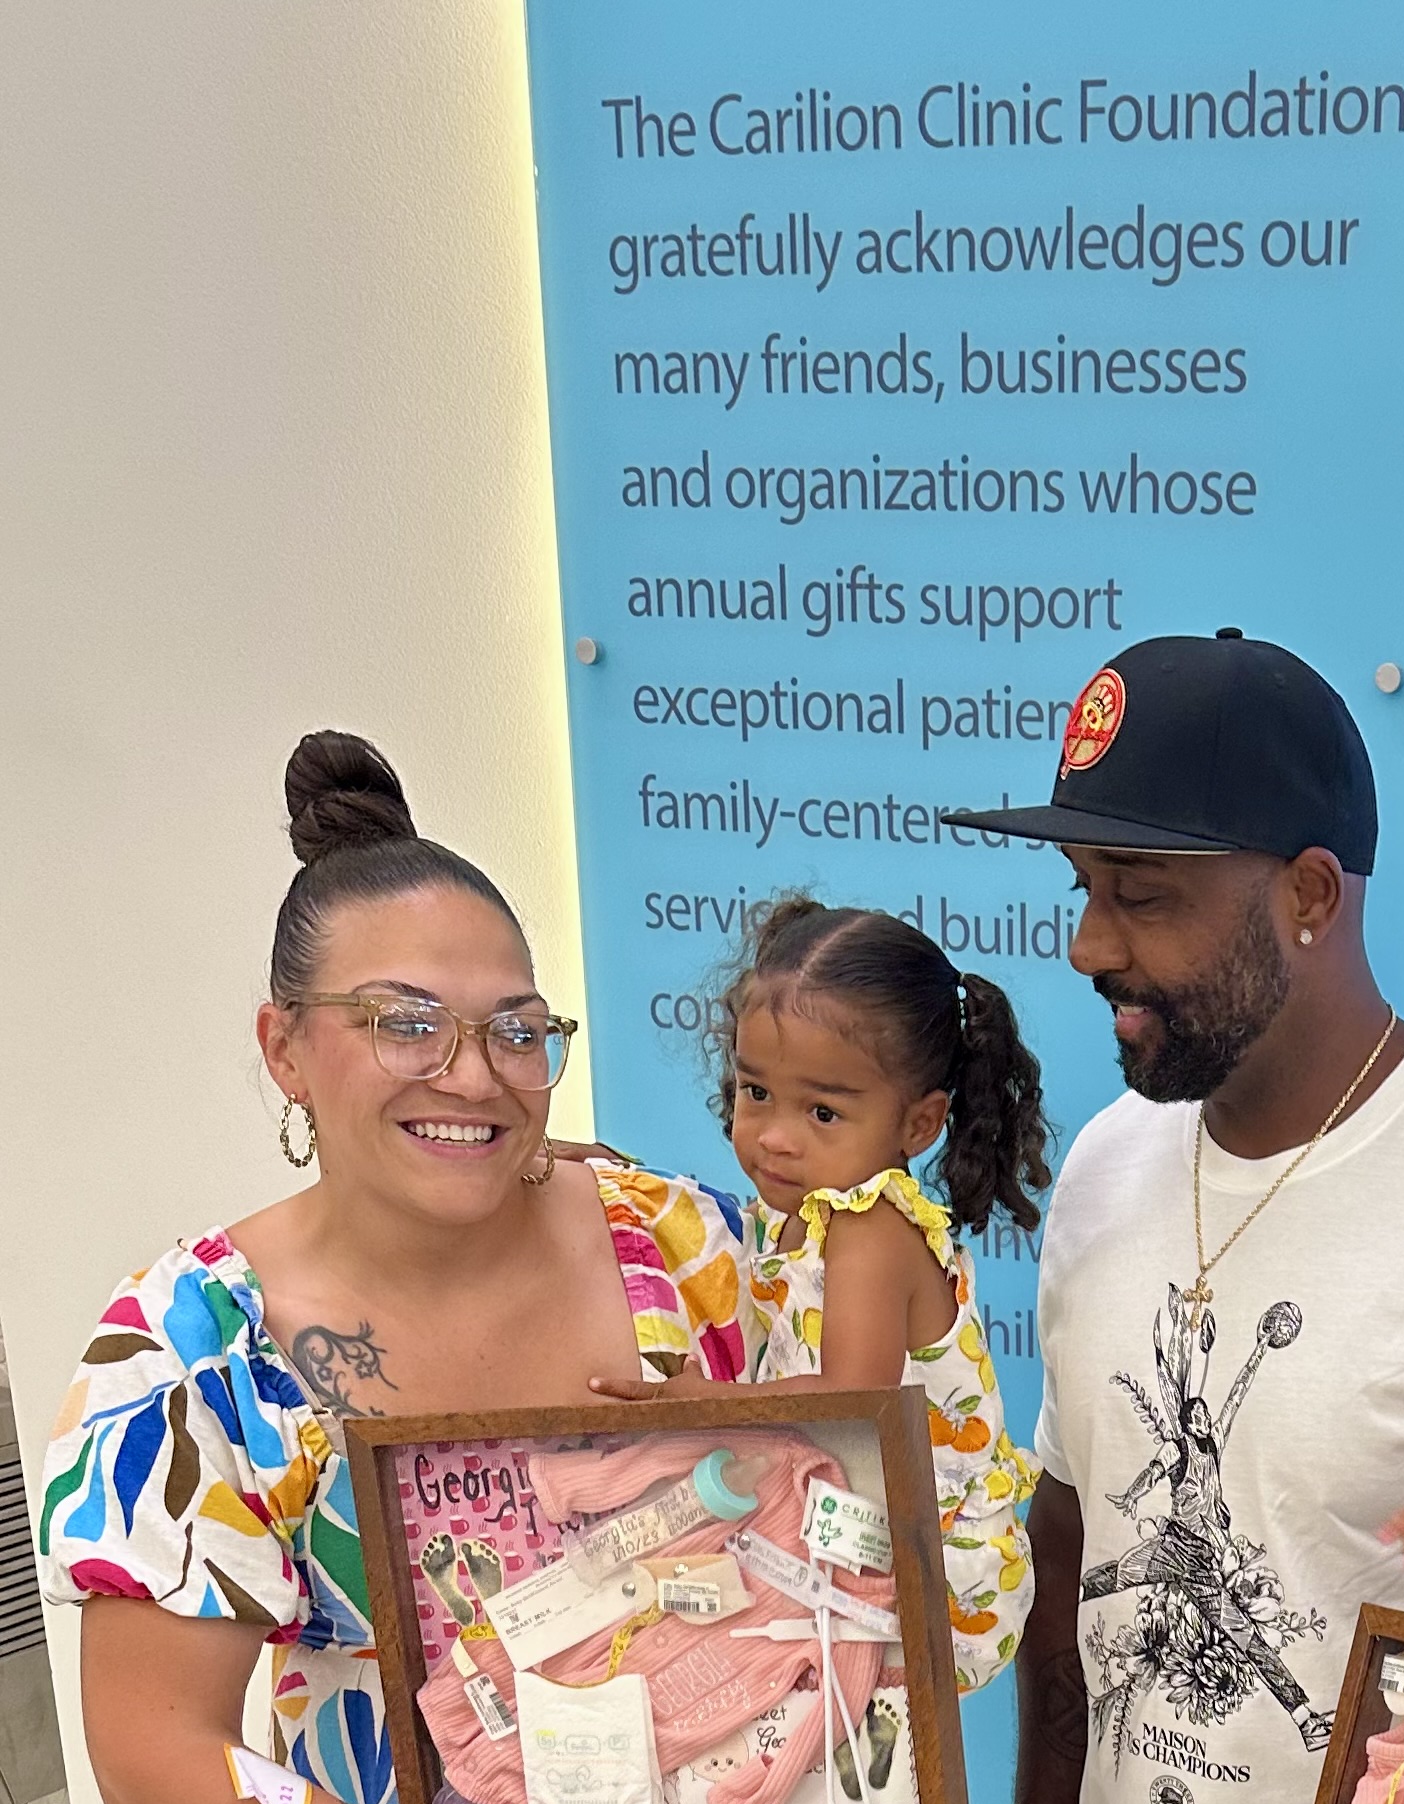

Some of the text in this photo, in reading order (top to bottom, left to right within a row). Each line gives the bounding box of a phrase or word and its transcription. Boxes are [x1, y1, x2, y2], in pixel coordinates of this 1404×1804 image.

[601, 95, 697, 159] The
[709, 86, 902, 156] Carilion
[917, 80, 1063, 149] Clinic
[608, 203, 1360, 295] gratefully acknowledges our
[614, 331, 1248, 411] many friends, businesses
[621, 449, 1257, 526] and organizations whose
[627, 563, 1123, 643] annual gifts support
[633, 677, 1071, 750] exceptional patien
[940, 897, 1074, 959] buildi
[414, 1453, 531, 1523] Georgi
[1142, 1722, 1207, 1759] MAISON
[1143, 1742, 1251, 1783] CHAMPIONS
